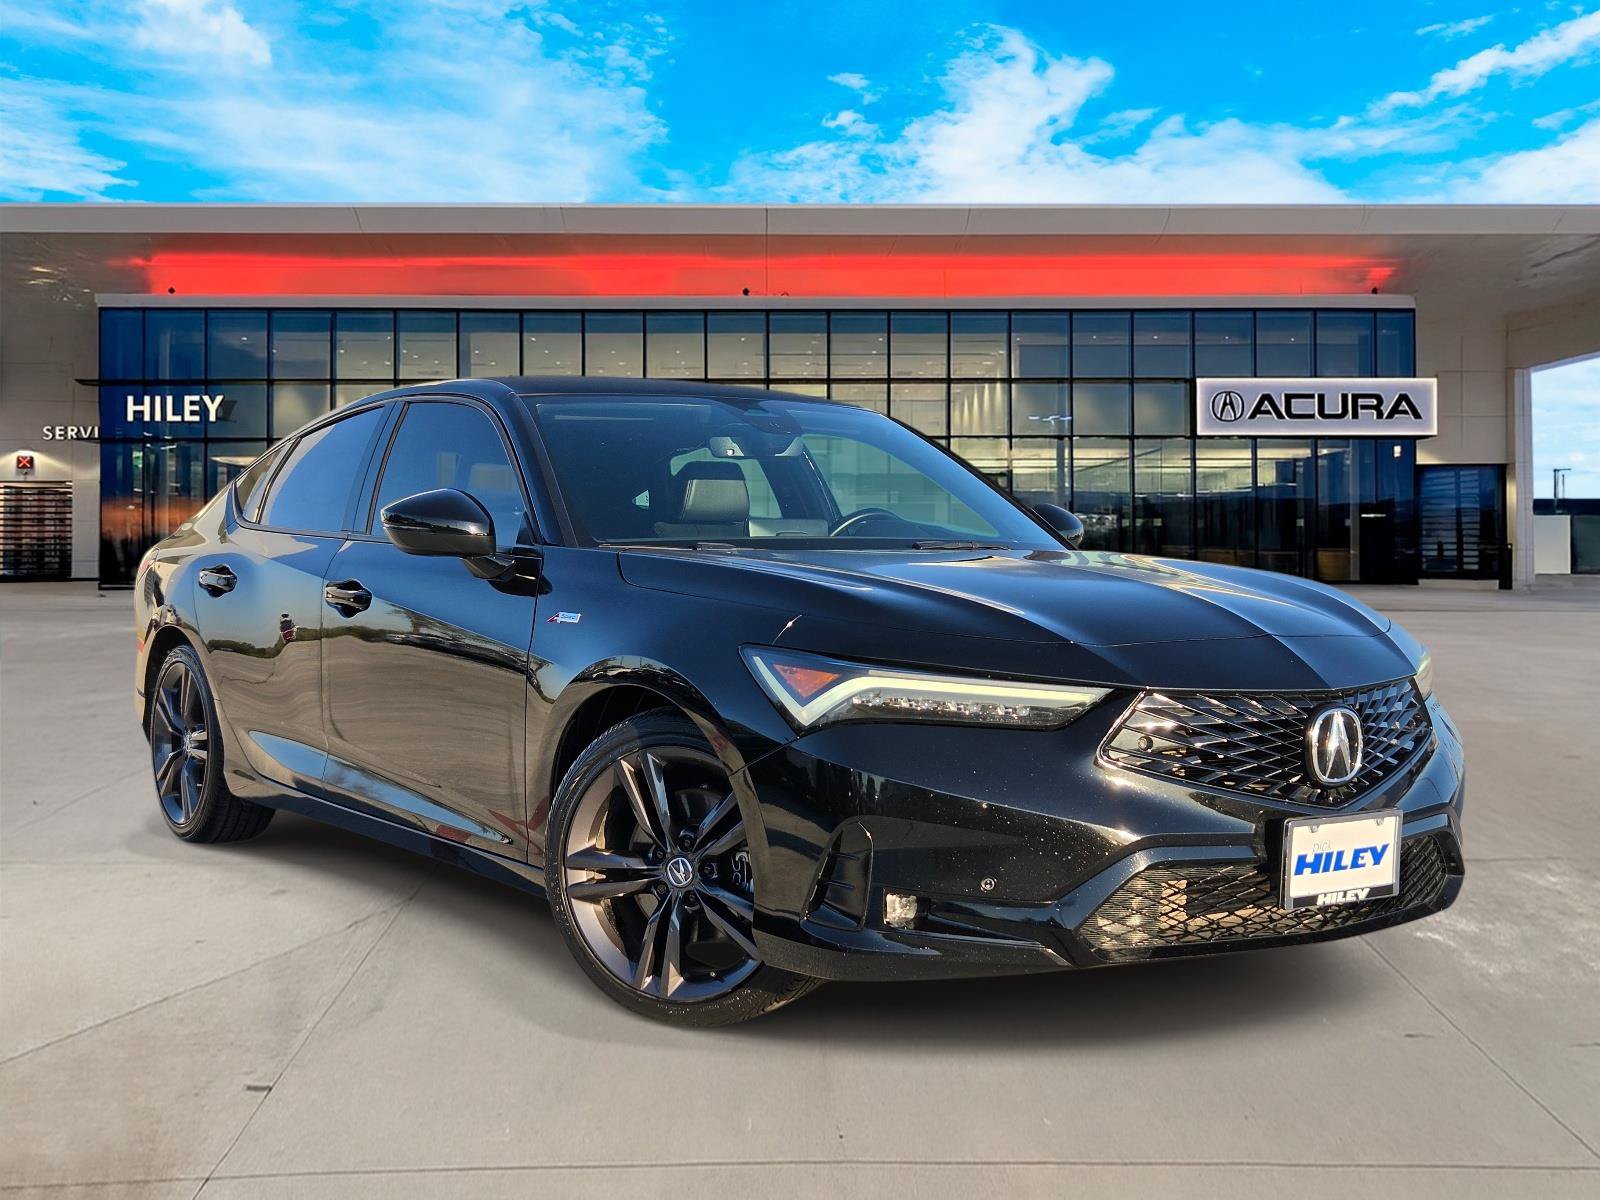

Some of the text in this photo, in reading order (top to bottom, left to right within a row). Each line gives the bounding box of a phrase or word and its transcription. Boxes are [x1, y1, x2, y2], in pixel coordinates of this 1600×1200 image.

[126, 395, 224, 422] HILEY
[1248, 393, 1423, 420] ACURA
[1293, 843, 1390, 876] HILEY
[1316, 887, 1371, 906] HILEY
